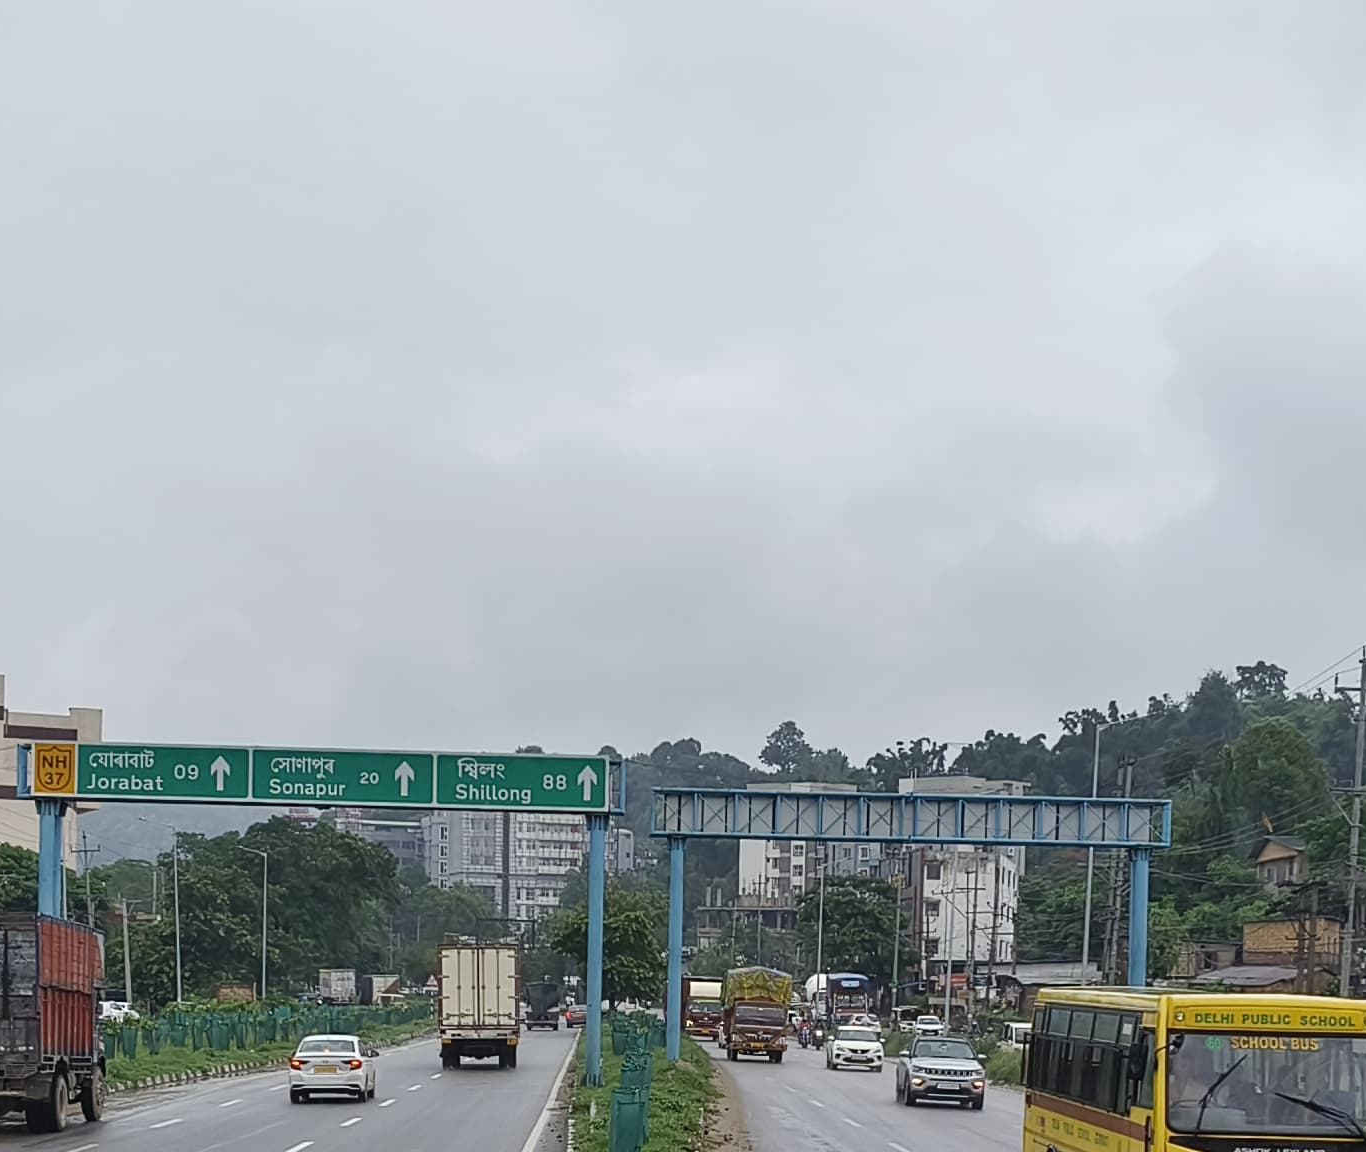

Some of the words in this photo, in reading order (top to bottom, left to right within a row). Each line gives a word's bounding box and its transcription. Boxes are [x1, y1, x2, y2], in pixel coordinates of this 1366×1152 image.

[42, 755, 67, 769] NH
[45, 772, 63, 785] 37
[174, 764, 199, 780] 09
[360, 771, 379, 784] 20
[87, 774, 163, 790] Jorabat
[269, 778, 346, 798] Sonapur
[542, 774, 567, 790] 88
[455, 783, 531, 804] Shillong
[1194, 1013, 1235, 1024] DELHI
[1241, 1013, 1292, 1025] PUBLIC
[1299, 1015, 1356, 1027] SCHOOL
[1230, 1036, 1288, 1050] SCHOOL
[1290, 1037, 1319, 1051] BUS
